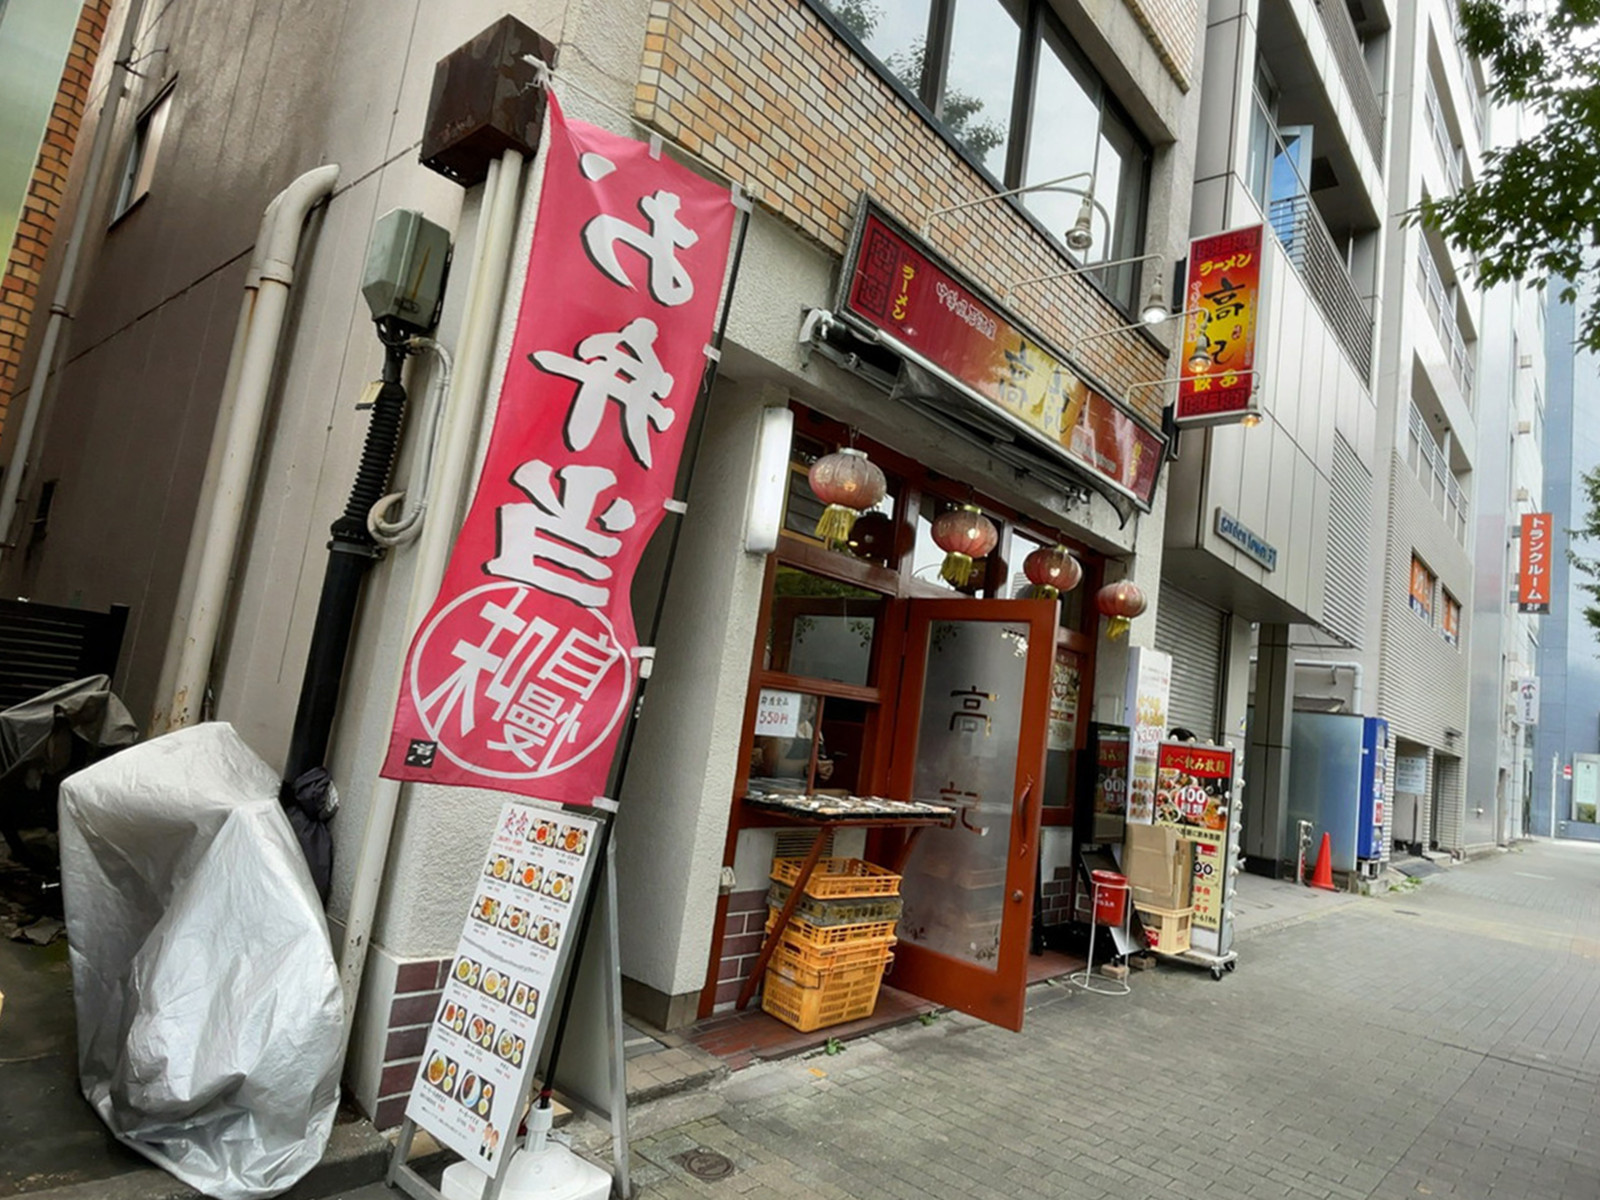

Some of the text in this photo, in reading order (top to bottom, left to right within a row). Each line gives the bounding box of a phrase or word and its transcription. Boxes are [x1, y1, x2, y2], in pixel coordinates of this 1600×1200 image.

[1200, 253, 1252, 277] ラーメン
[892, 264, 915, 320] ラーメン
[1528, 517, 1545, 600] トランクルーム
[1526, 603, 1541, 612] 2F
[1180, 787, 1206, 804] 100
